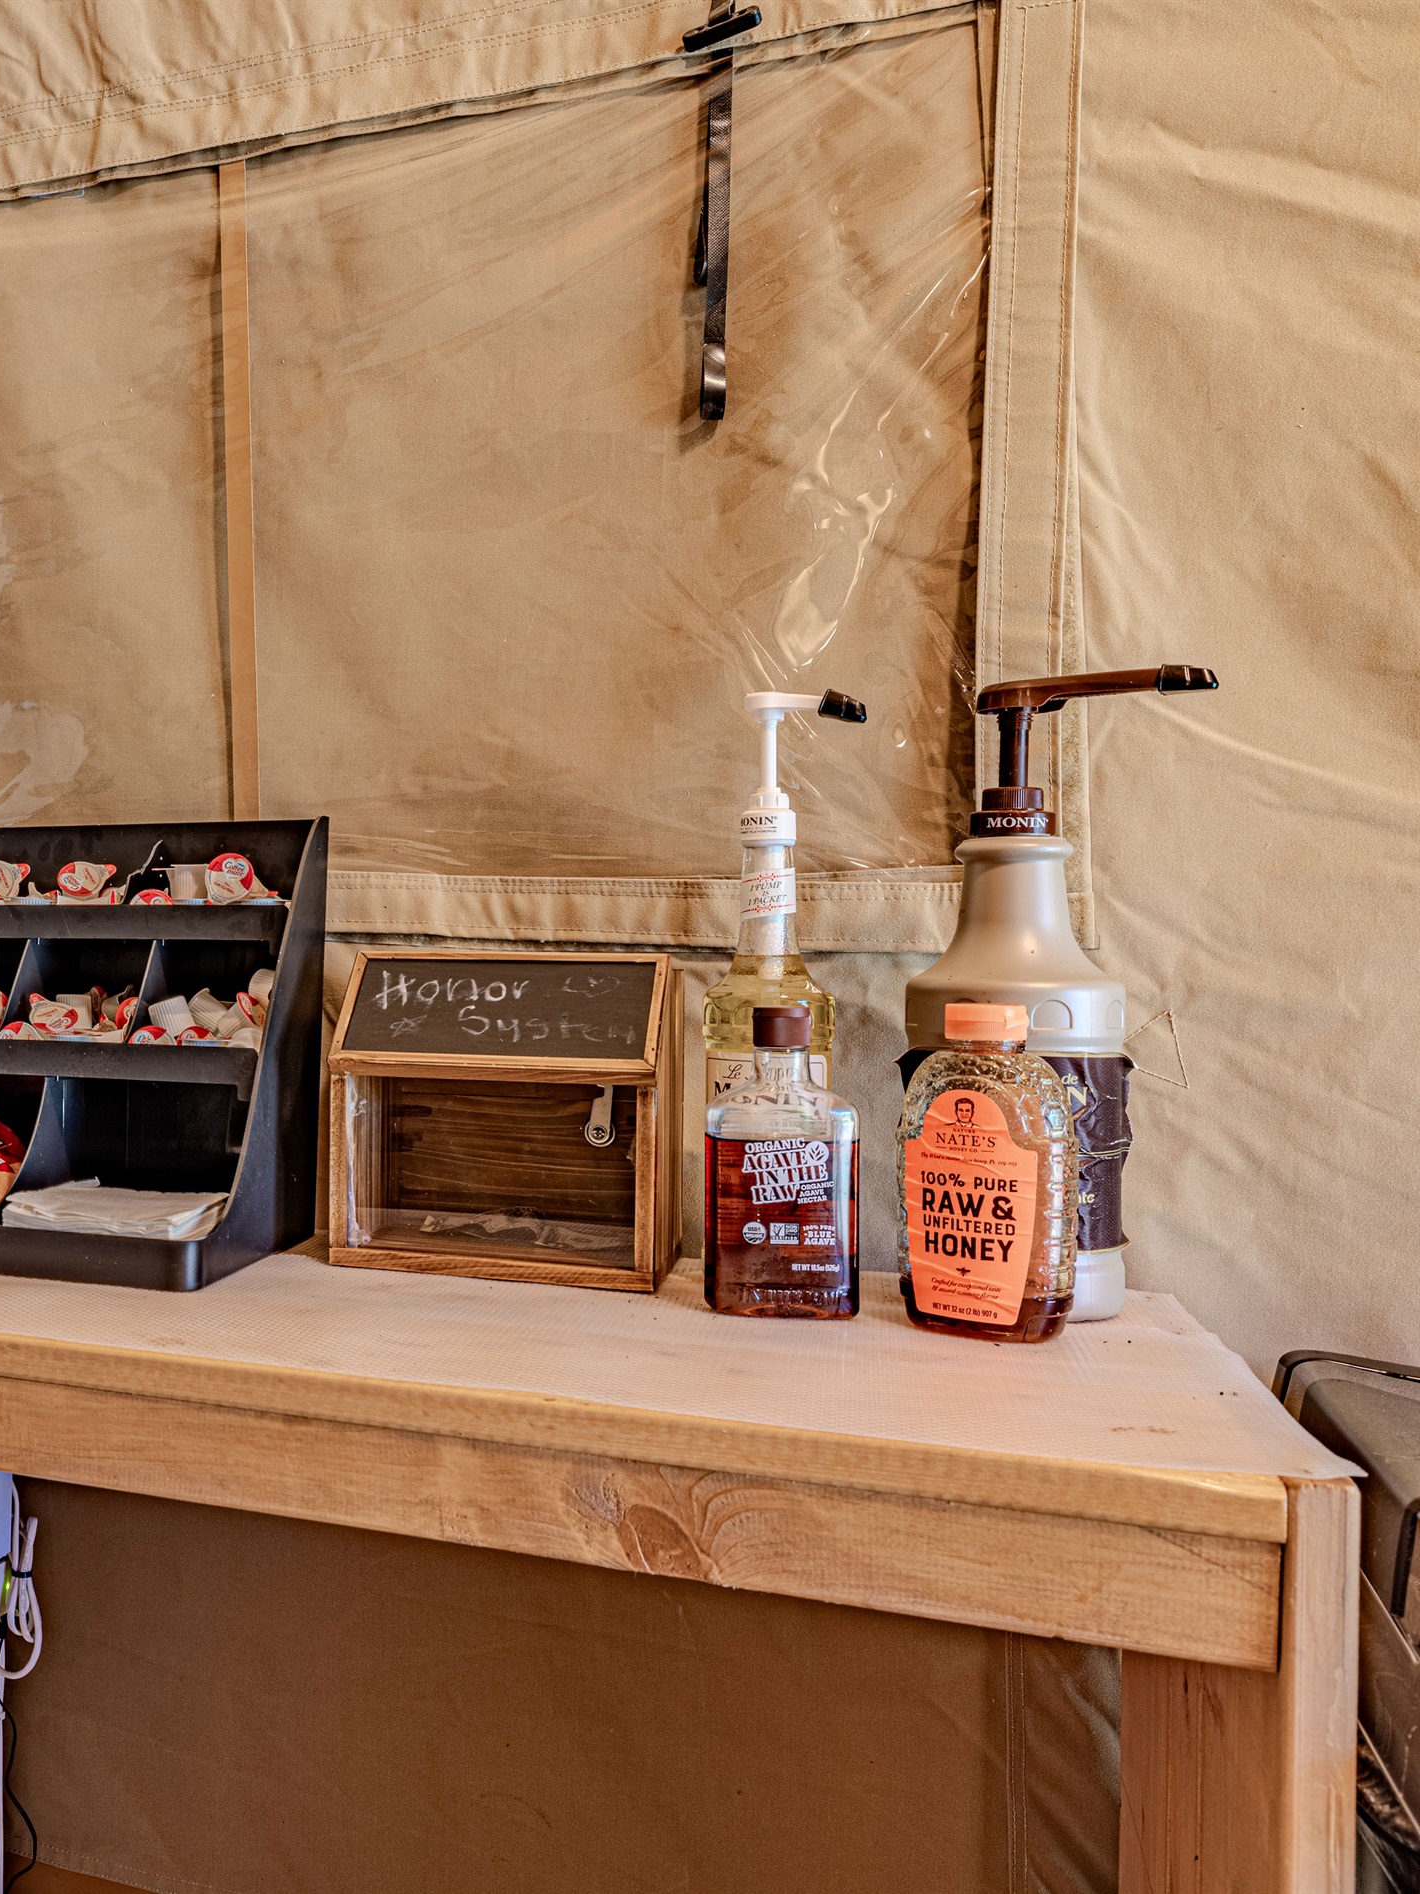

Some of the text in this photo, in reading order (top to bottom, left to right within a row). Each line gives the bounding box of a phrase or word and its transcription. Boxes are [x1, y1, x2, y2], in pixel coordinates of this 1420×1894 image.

[986, 816, 1047, 828] MONIN
[224, 862, 245, 874] Coffee
[226, 869, 245, 877] mate
[213, 881, 235, 895] ORIGINAL
[754, 881, 782, 891] PUMP
[753, 894, 787, 905] PACKET
[376, 970, 530, 1009] Honor
[723, 1064, 742, 1080] Le
[1062, 1073, 1079, 1085] de
[745, 1138, 806, 1153] ORGANIC
[936, 1132, 996, 1148] NATE'S
[743, 1150, 808, 1172] AGAVE
[756, 1164, 827, 1186] IN THE
[920, 1171, 1018, 1192] 100% PURE
[799, 1189, 824, 1197] AGAVE
[801, 1181, 835, 1191] ORGANIC
[751, 1184, 797, 1204] RAW
[797, 1195, 827, 1204] NECTAR
[922, 1188, 1017, 1221] RAW &
[923, 1214, 1016, 1236] UNFILTERED
[924, 1230, 1015, 1263] HONEY
[792, 1263, 801, 1271] NET
[801, 1263, 810, 1271] WT
